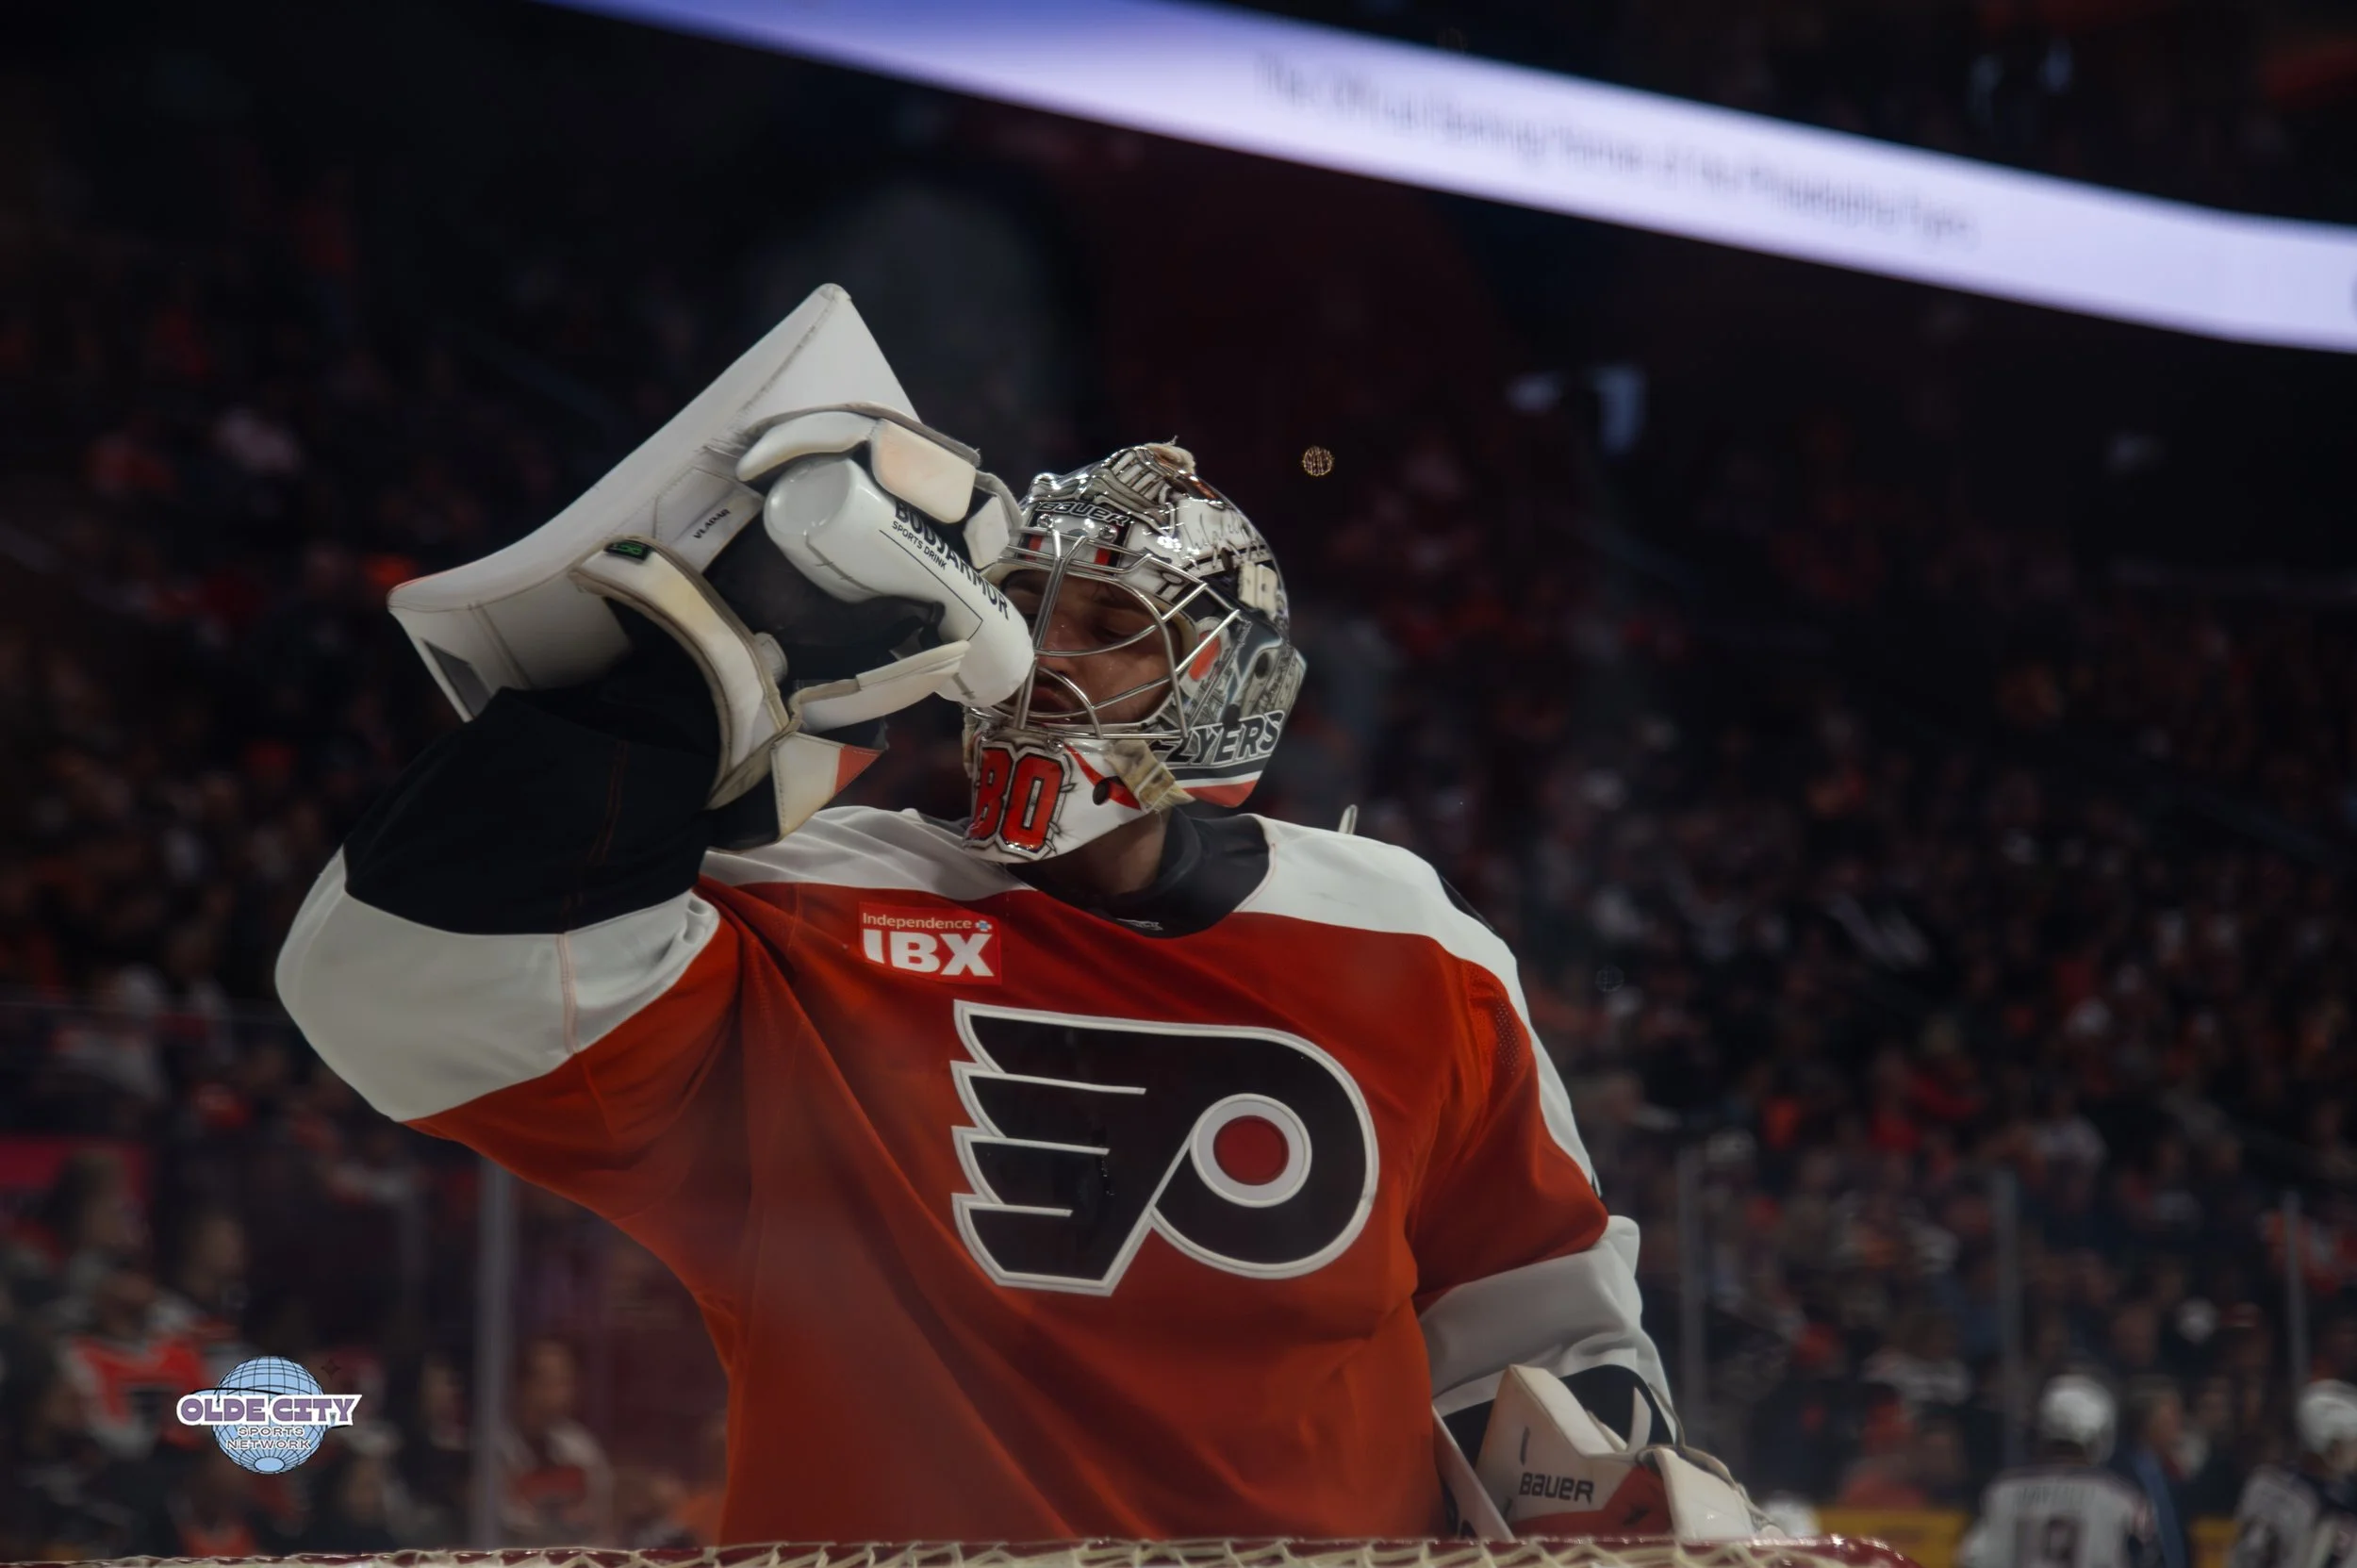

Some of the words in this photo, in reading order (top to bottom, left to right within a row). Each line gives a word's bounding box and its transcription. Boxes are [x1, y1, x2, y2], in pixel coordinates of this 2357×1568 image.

[892, 520, 924, 550] SPORTS
[923, 546, 948, 570] DRINK
[965, 744, 1066, 855] 80
[863, 912, 972, 929] Independence
[863, 929, 995, 977] IBX
[1519, 1472, 1595, 1505] BAUER
